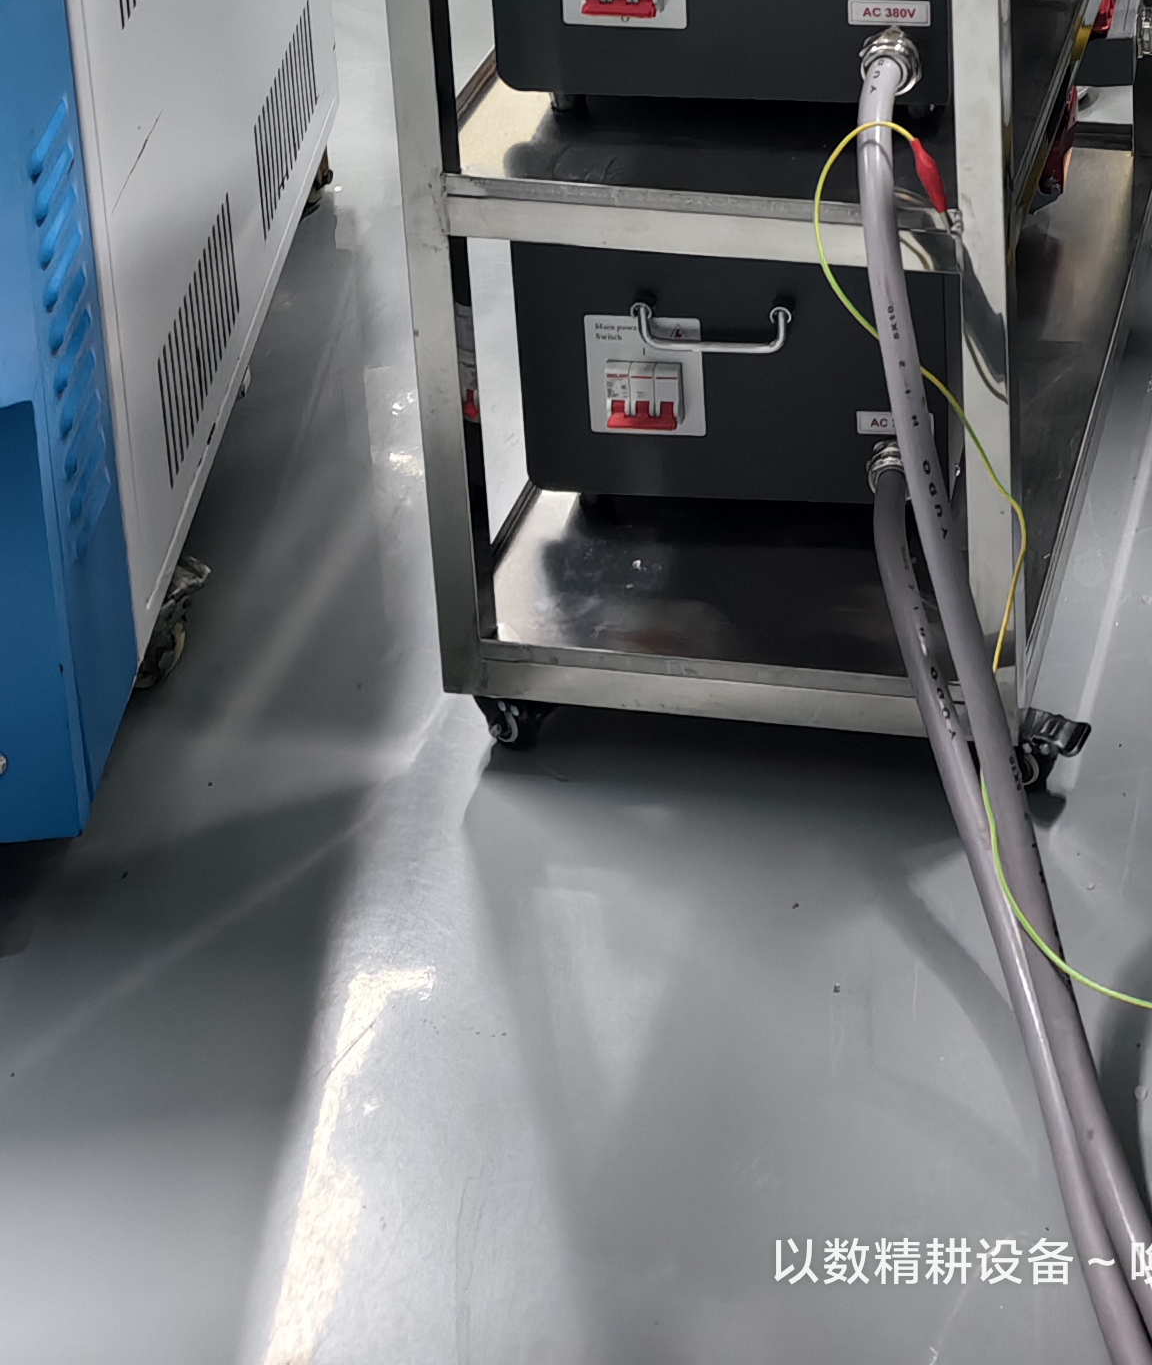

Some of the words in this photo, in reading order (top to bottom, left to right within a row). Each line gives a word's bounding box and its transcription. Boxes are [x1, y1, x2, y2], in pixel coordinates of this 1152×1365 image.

[863, 7, 881, 17] AC
[885, 7, 916, 18] 380V
[870, 418, 888, 427] AC
